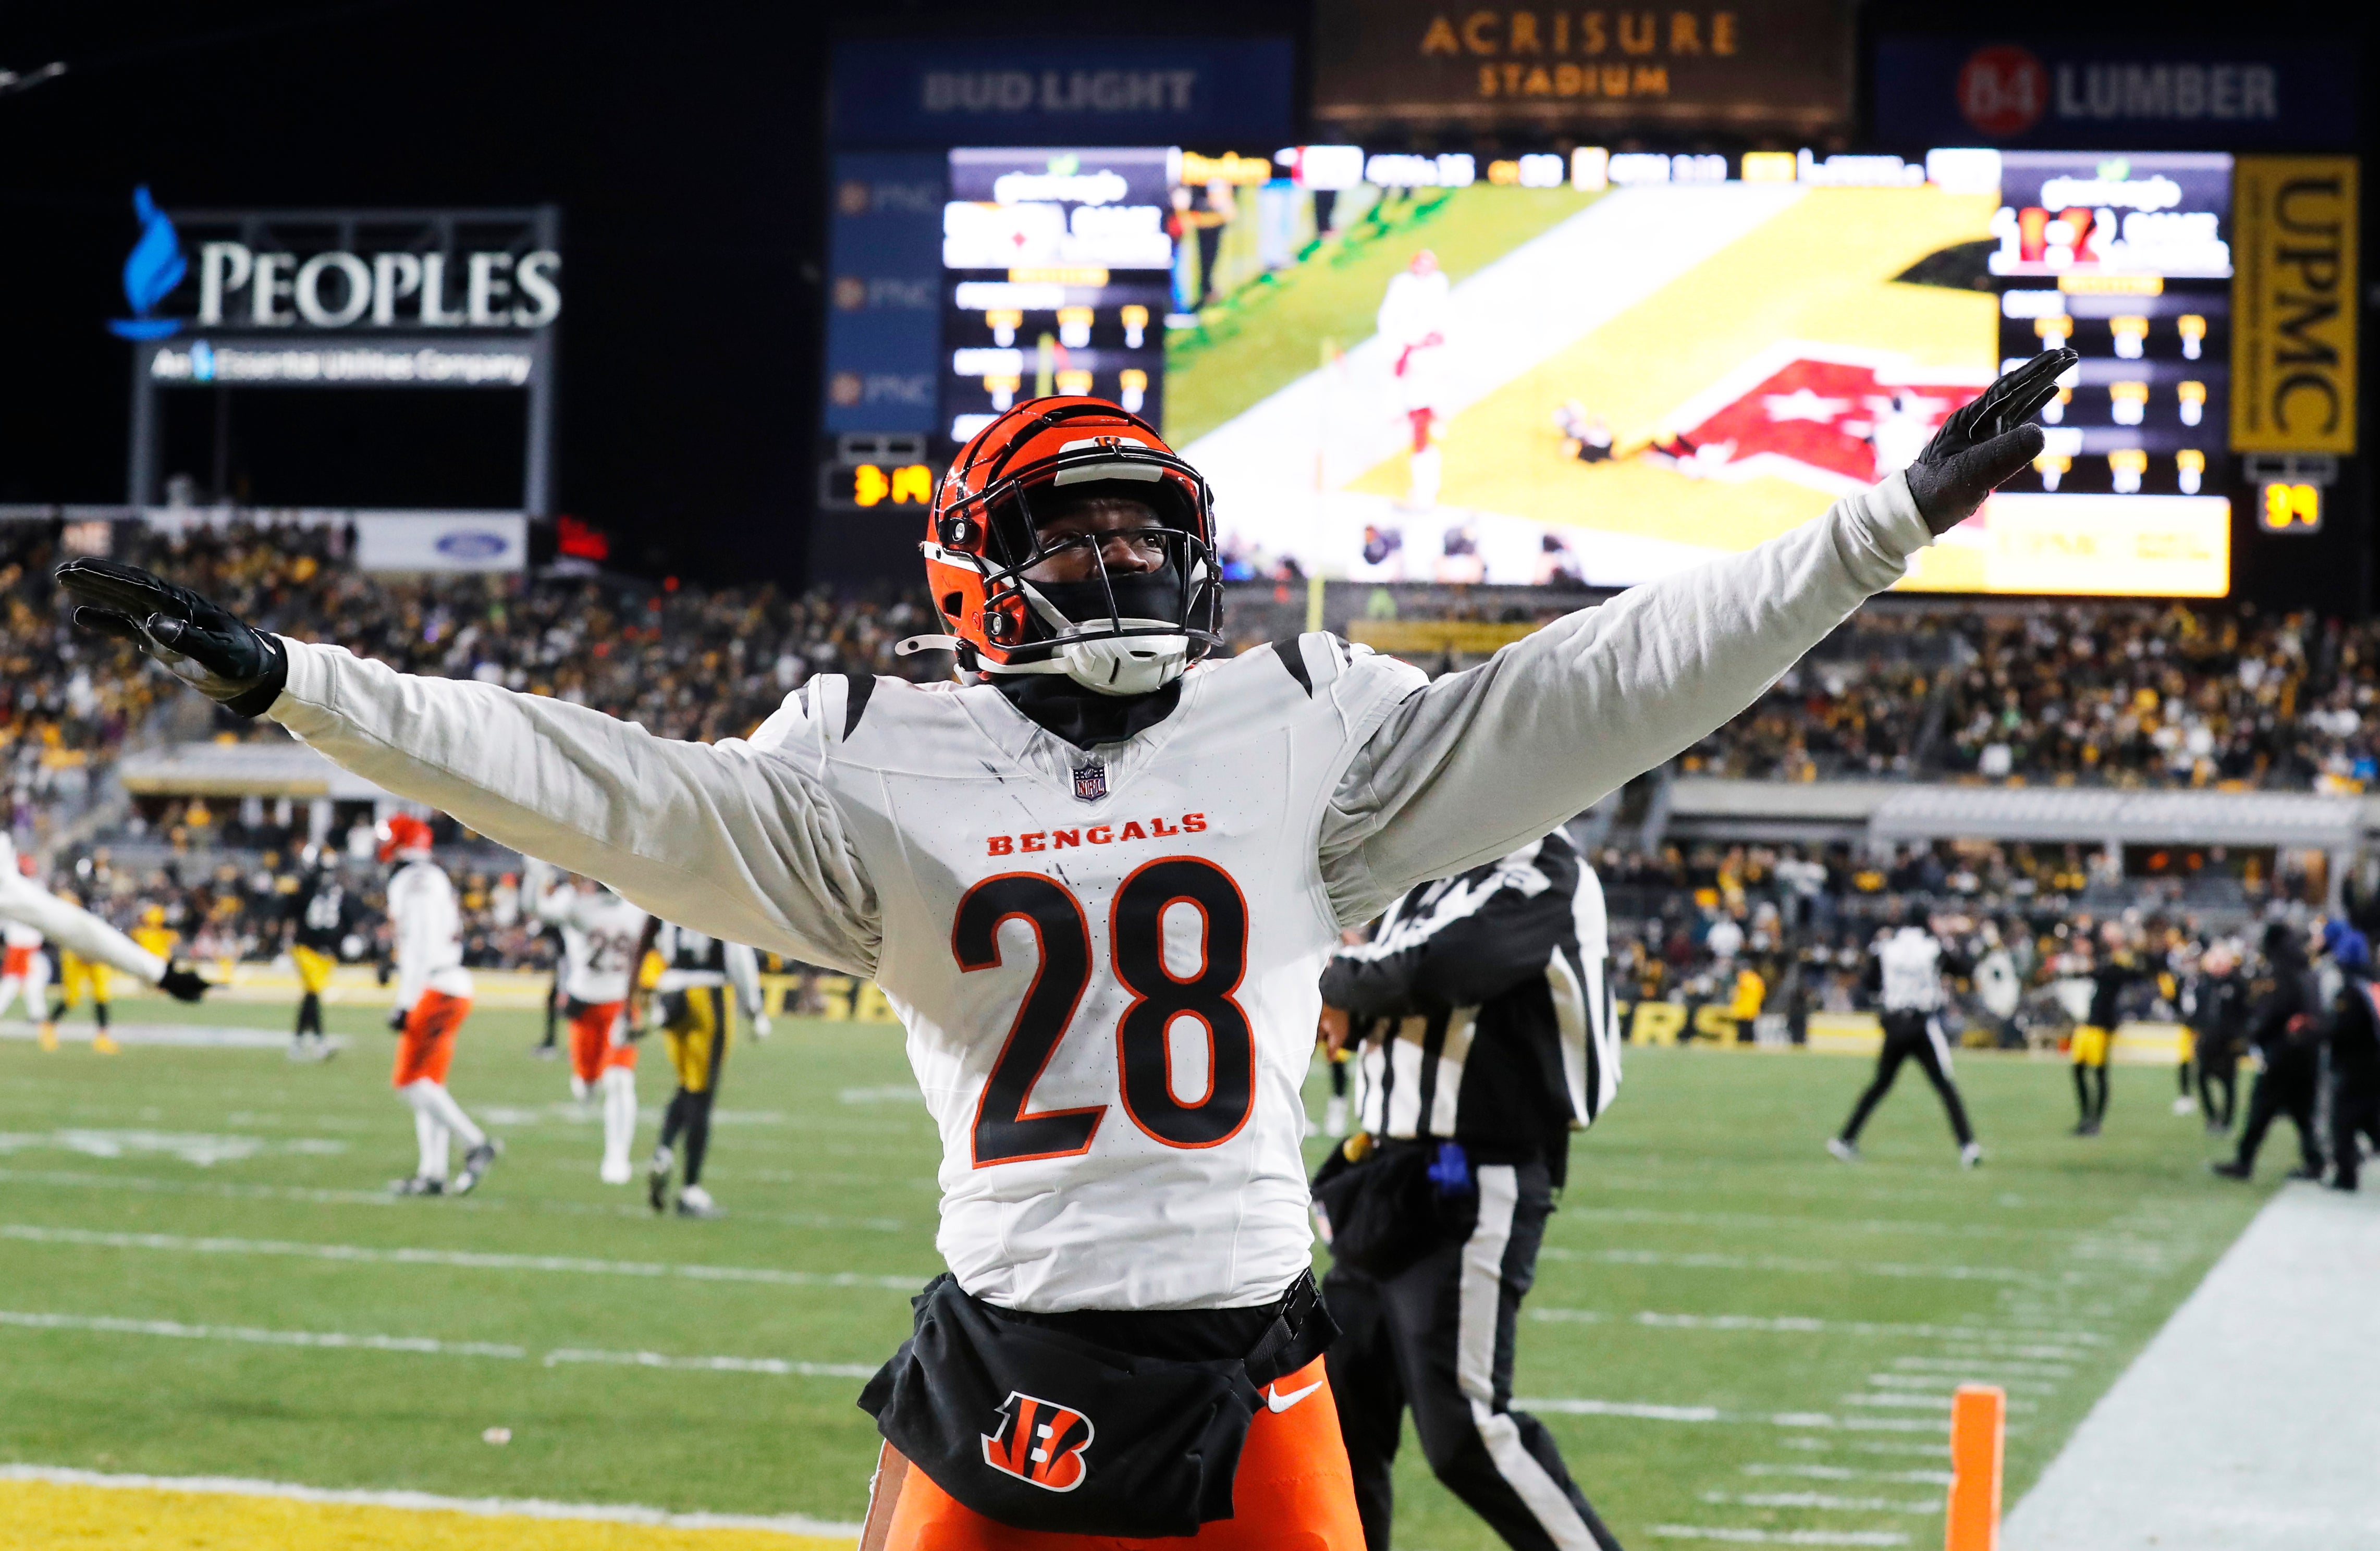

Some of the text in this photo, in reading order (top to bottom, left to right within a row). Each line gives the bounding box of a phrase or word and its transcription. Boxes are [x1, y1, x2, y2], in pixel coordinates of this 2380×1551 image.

[1423, 11, 1737, 56] ACRISURE
[922, 68, 1197, 113] BUD LIGHT
[1479, 63, 1669, 96] STADIUM
[2057, 63, 2278, 119] LUMBER
[200, 241, 561, 328] PEOPLES
[2274, 177, 2341, 436] UPMC
[1077, 779, 1105, 797] NFL
[987, 812, 1208, 856] BENGALS
[951, 855, 1255, 1170] 28
